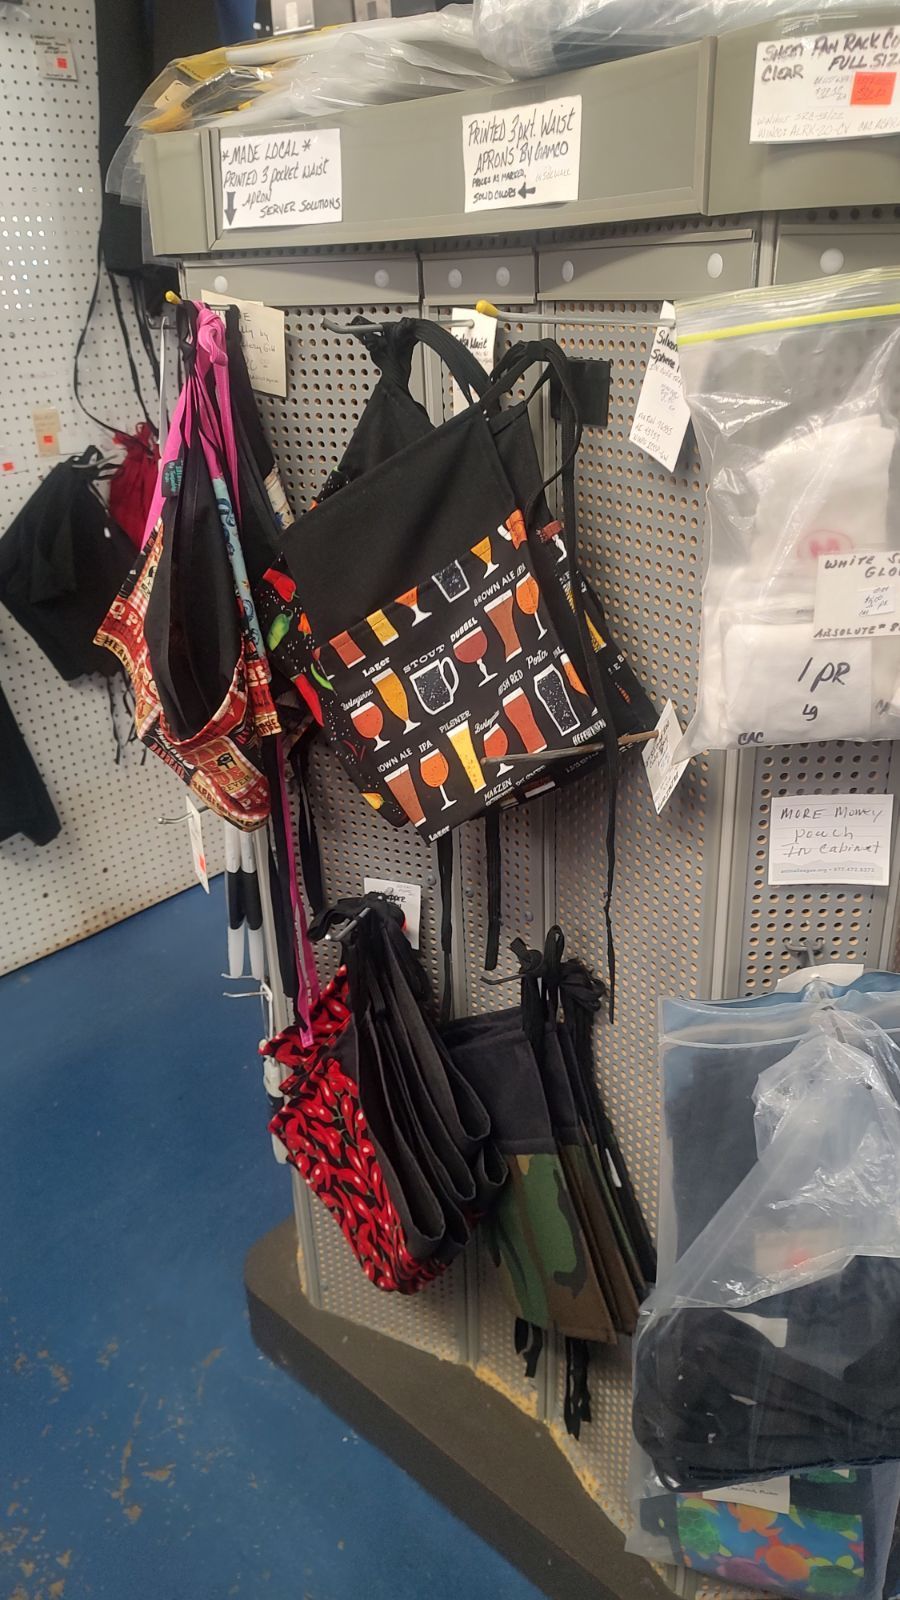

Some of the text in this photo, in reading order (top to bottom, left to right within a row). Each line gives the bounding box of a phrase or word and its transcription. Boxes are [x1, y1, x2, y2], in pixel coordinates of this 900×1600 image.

[844, 31, 880, 51] RACK
[828, 53, 900, 71] FULL SIZ
[265, 139, 300, 160] LOCAL
[474, 146, 515, 175] APRONS
[534, 140, 569, 161] GAMCO
[223, 169, 258, 188] PRINTED
[260, 165, 270, 184] 3
[492, 173, 501, 184] AS
[473, 190, 494, 204] SOLID
[260, 197, 341, 218] SERVER SOLUTIONS
[864, 566, 900, 579] GLO
[473, 570, 517, 607] BROWN ALE
[450, 617, 478, 642] DUBBEL
[813, 625, 877, 639] ABSOLUTE
[362, 656, 391, 677] Lager
[403, 644, 445, 673] STOUT
[509, 669, 524, 684] RED
[438, 709, 472, 734] PILSNER
[399, 747, 413, 761] ALE
[418, 739, 434, 753] IPA
[780, 806, 883, 824] MORE Money
[794, 826, 854, 844] pouch
